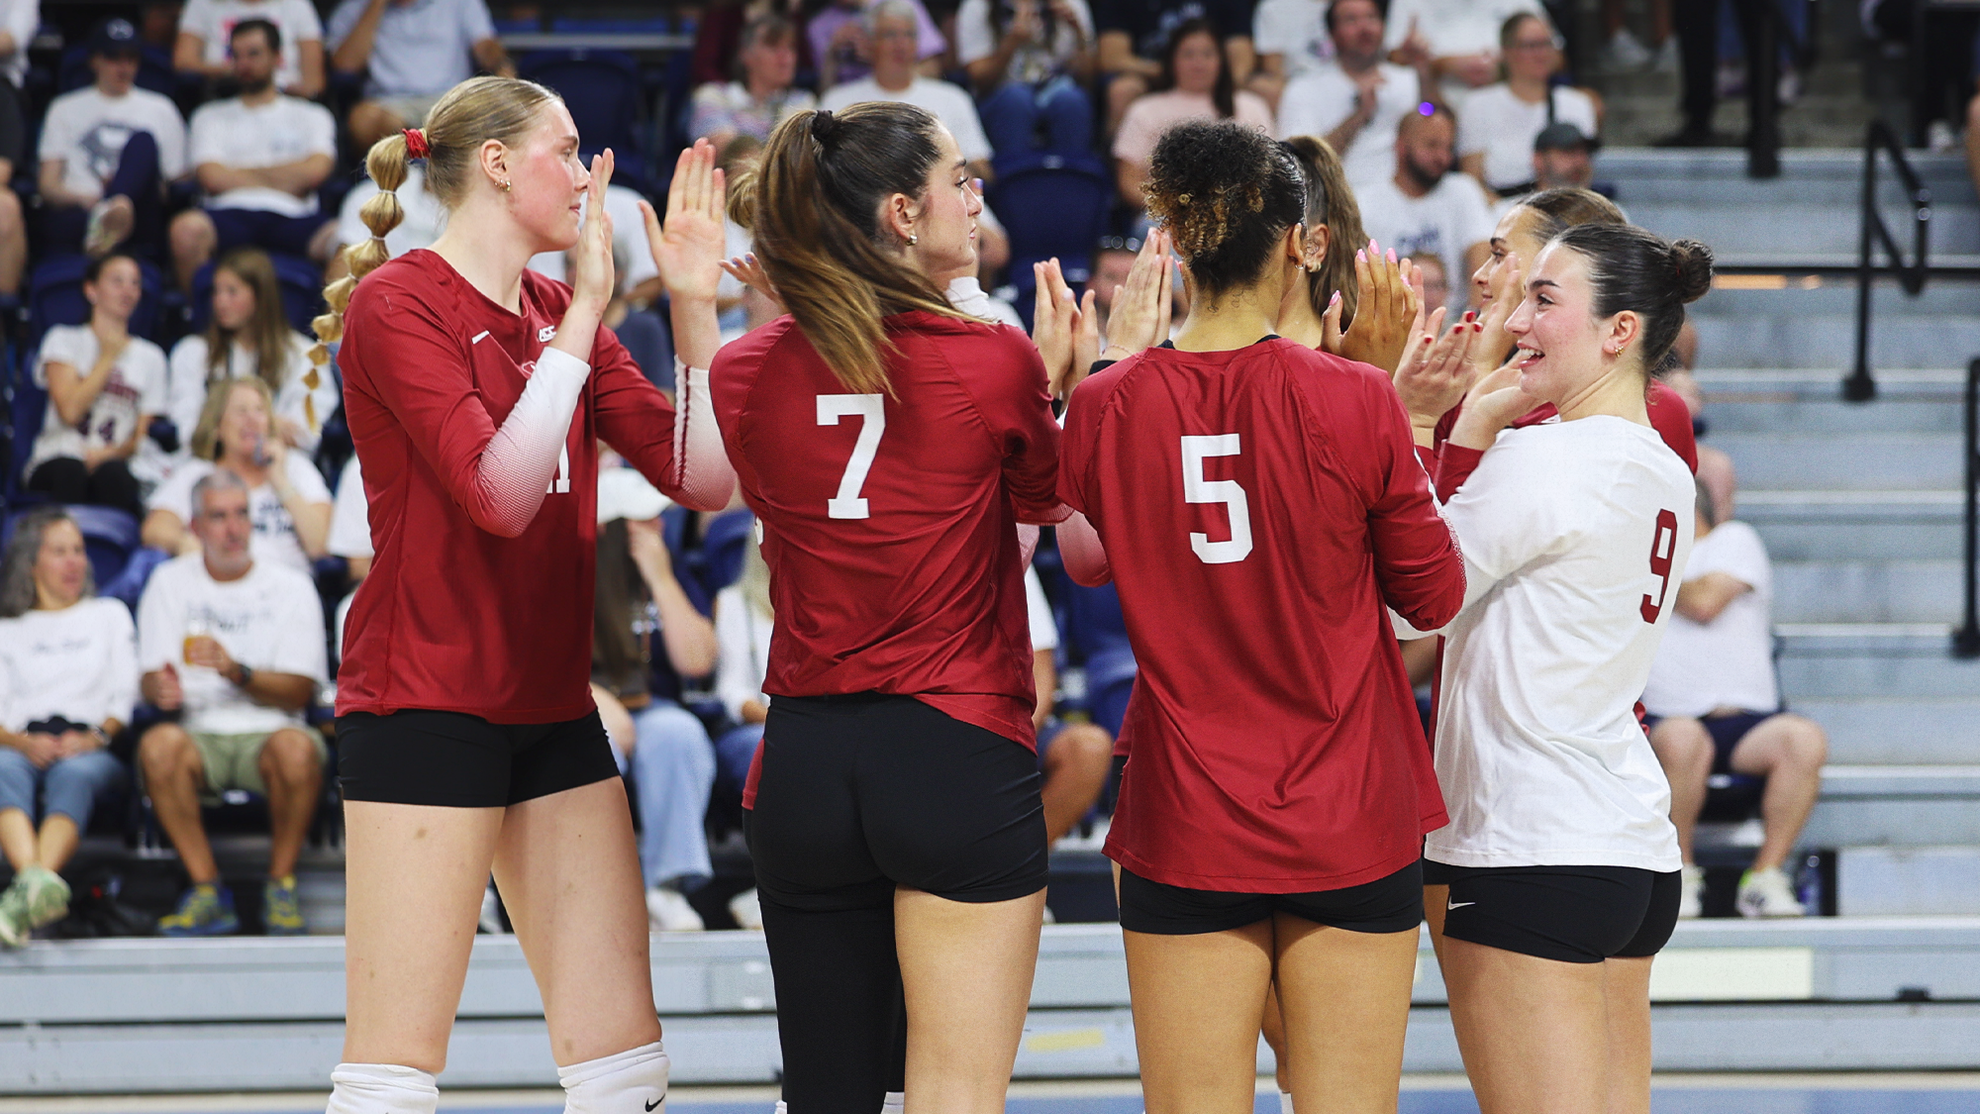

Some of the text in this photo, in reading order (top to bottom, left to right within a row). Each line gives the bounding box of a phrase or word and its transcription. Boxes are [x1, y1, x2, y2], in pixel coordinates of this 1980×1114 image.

[816, 393, 886, 519] 7
[1181, 433, 1253, 564] 5
[1639, 508, 1678, 624] 9
